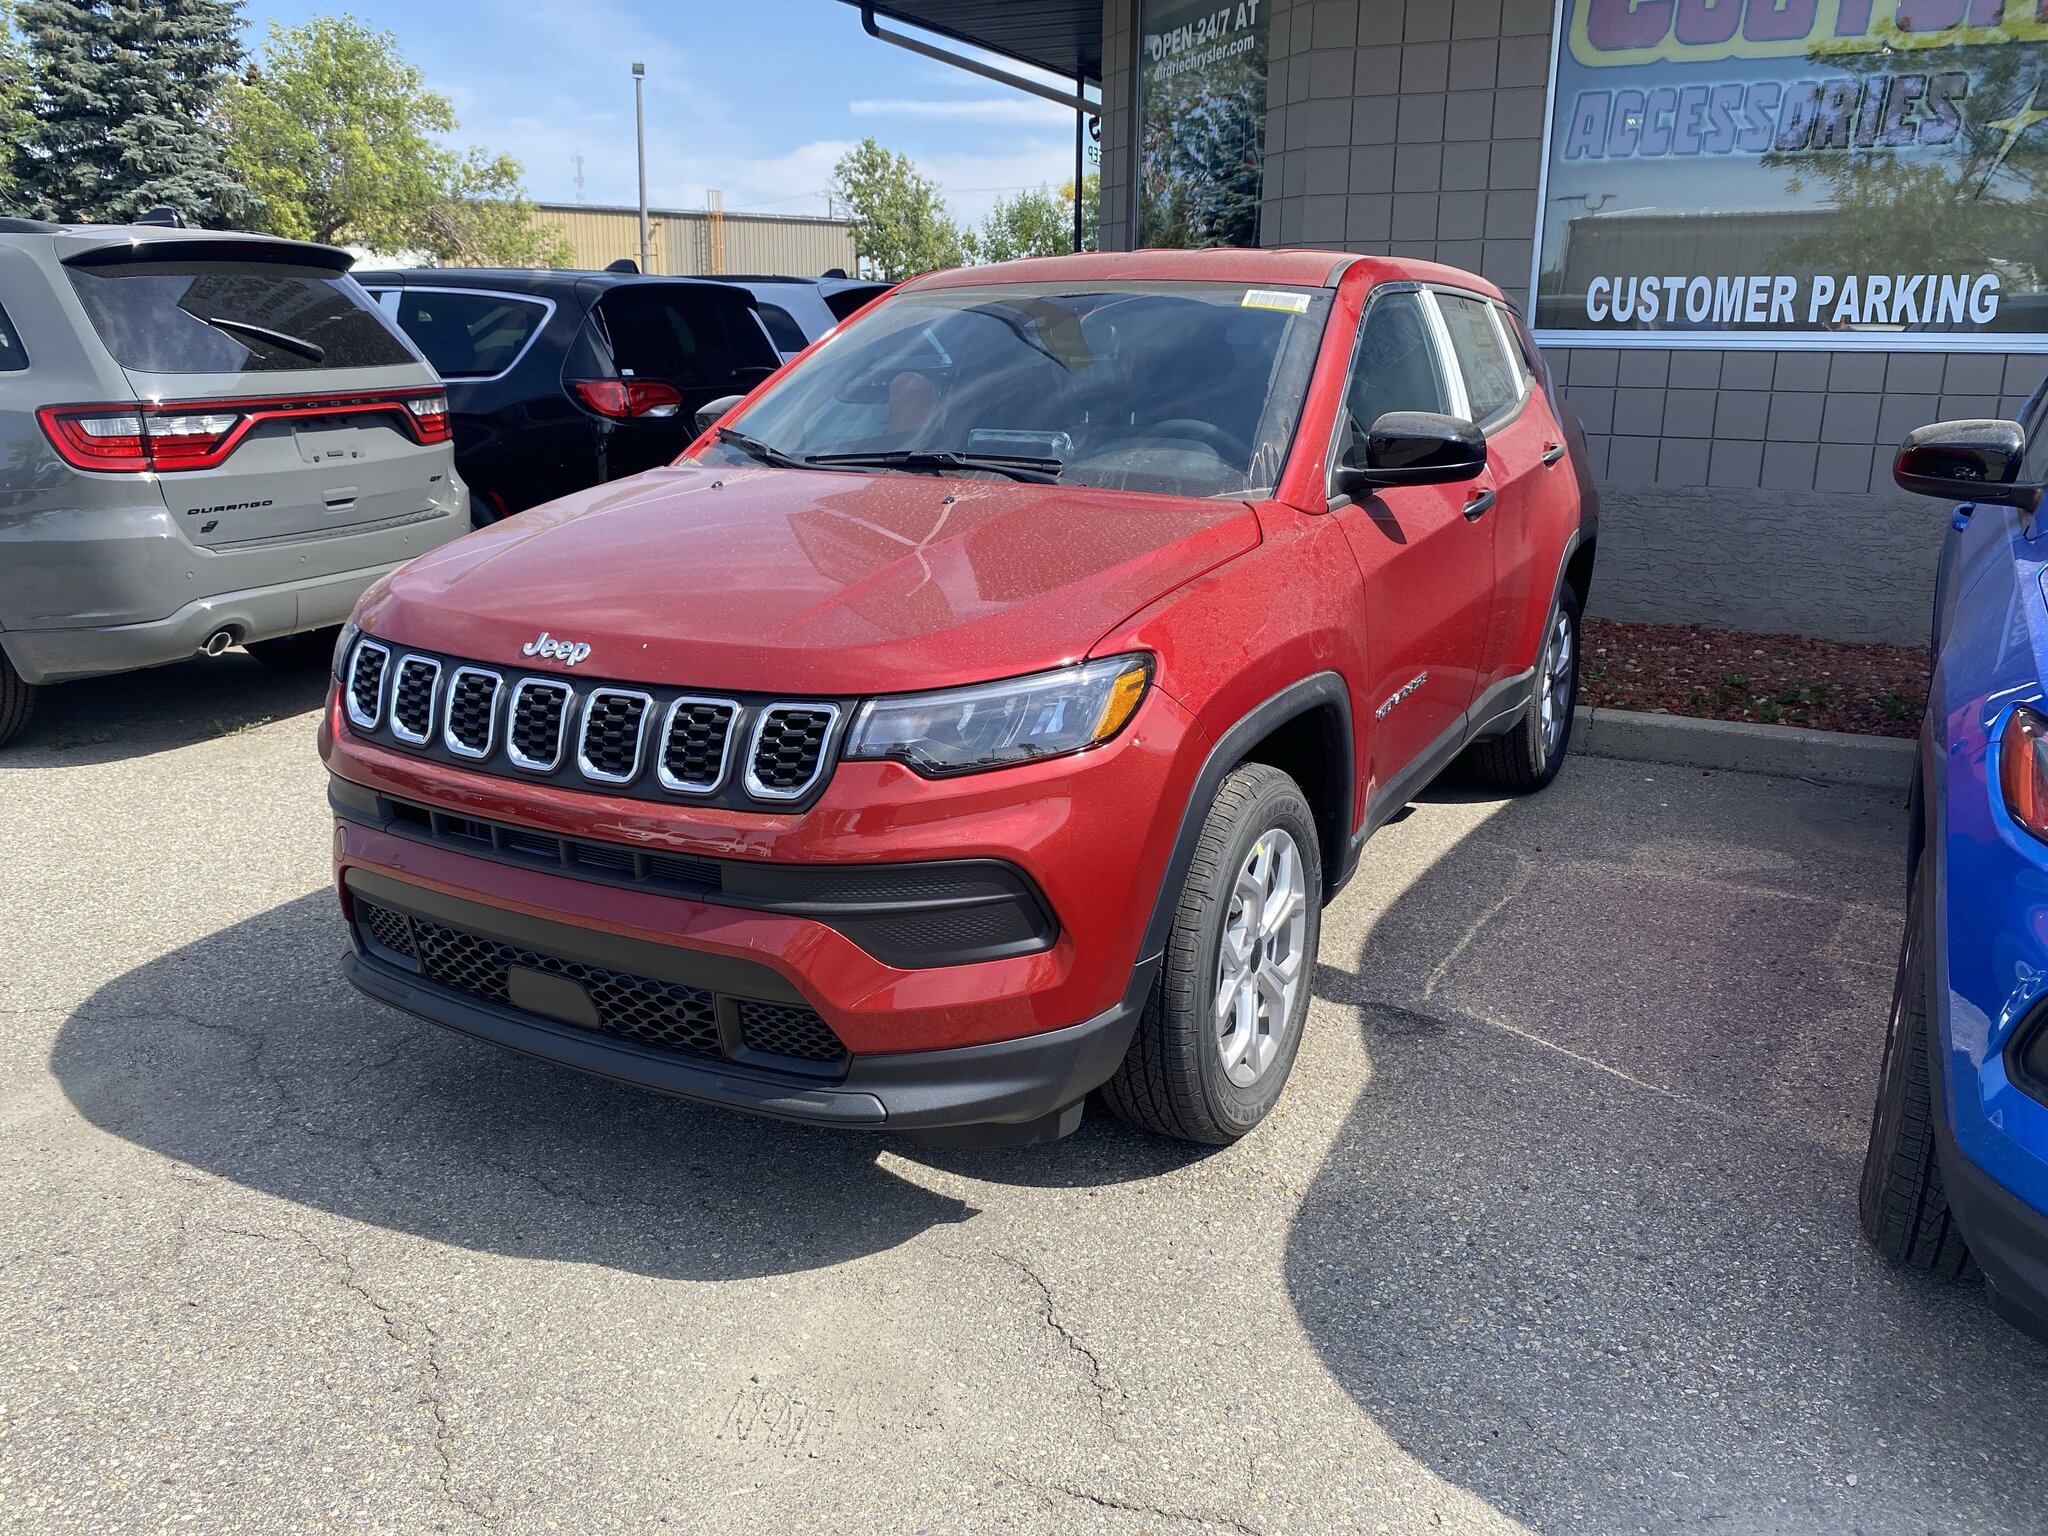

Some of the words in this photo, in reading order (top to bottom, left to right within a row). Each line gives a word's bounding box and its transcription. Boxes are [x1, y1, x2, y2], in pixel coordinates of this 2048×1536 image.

[1152, 23, 1193, 62] OPEN
[1197, 8, 1231, 45] 24/7
[1234, 0, 1260, 31] AT
[1154, 34, 1255, 82] airdriechrysler.com
[1564, 71, 1970, 161] ACCESSORIES
[1586, 275, 1797, 323] CUSTOMER
[1808, 274, 2001, 324] PARKING
[187, 500, 273, 516] DURANGO
[522, 631, 591, 666] Jeep
